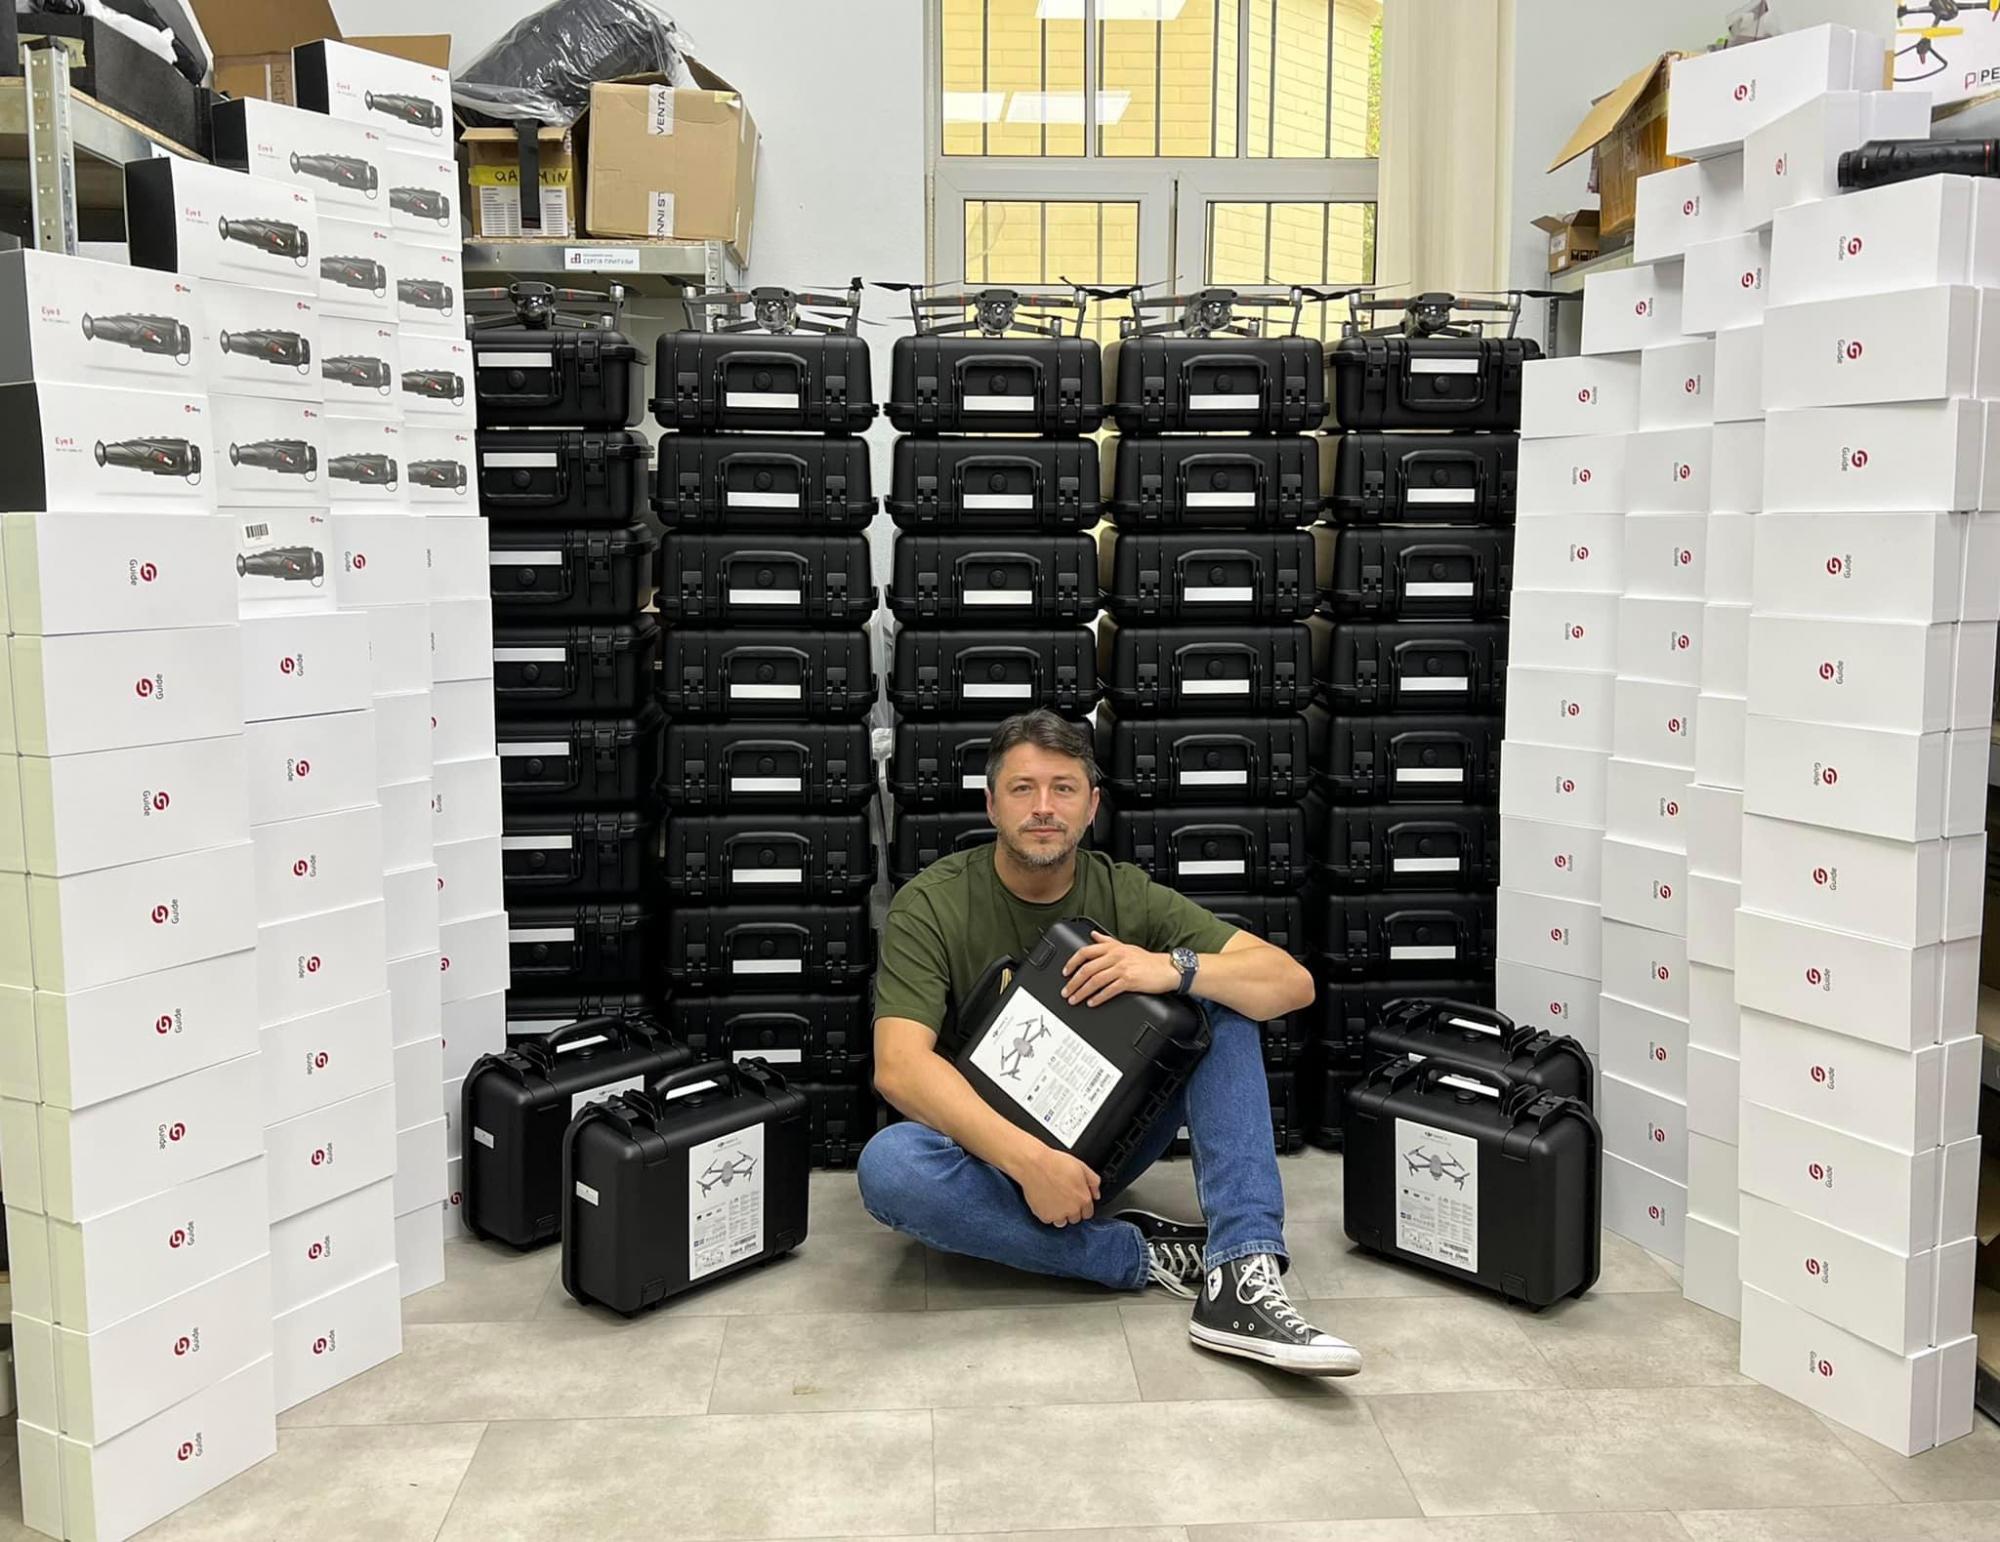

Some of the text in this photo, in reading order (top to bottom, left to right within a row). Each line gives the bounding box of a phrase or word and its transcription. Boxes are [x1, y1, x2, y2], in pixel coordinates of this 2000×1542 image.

[1748, 78, 1757, 103] Guide
[656, 90, 667, 135] VENTA
[1837, 235, 1847, 262] Guide
[1836, 338, 1846, 365] Guide
[1840, 446, 1851, 472] Guide
[128, 558, 139, 587] Guide
[1843, 553, 1852, 579] Guide
[296, 653, 305, 677] Guide
[1835, 659, 1845, 685] Guide
[155, 673, 165, 701] Guide
[286, 757, 295, 782] Guide
[1812, 761, 1822, 787] Guide
[142, 789, 152, 817] Guide
[309, 854, 317, 878] Guide
[1828, 866, 1838, 891] Guide
[170, 898, 180, 925] Guide
[297, 955, 306, 979] Guide
[1822, 967, 1831, 992] Guide
[173, 1007, 183, 1034] Guide
[305, 1052, 314, 1076] Guide
[1826, 1066, 1836, 1091] Guide
[158, 1123, 167, 1150] Guide
[1824, 1164, 1833, 1189] Guide
[186, 1220, 196, 1247] Guide
[323, 1234, 331, 1258] Guide
[1821, 1260, 1829, 1284] Guide
[191, 1326, 200, 1353] Guide
[194, 1431, 204, 1458] Guide
